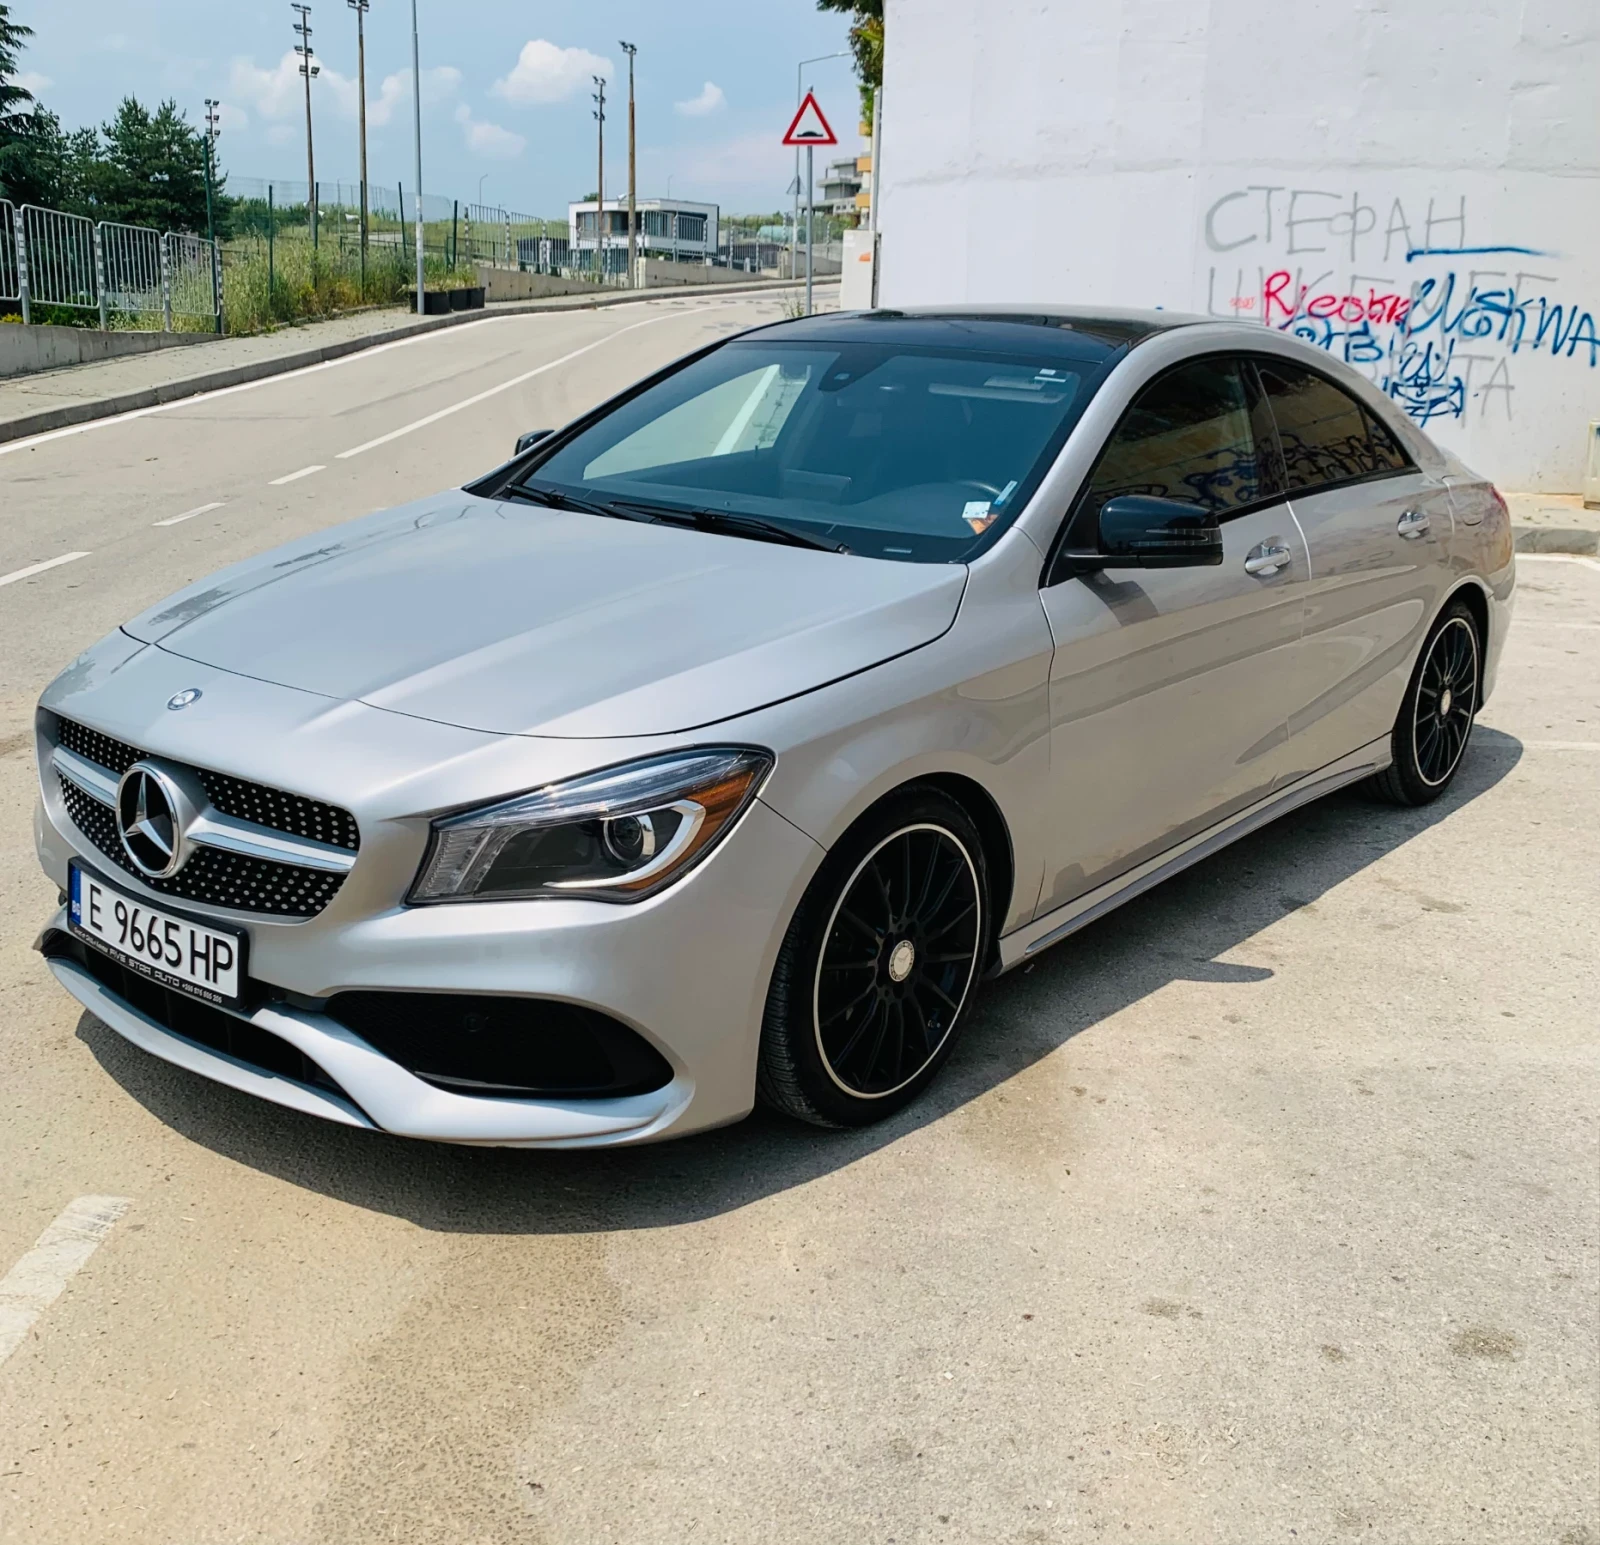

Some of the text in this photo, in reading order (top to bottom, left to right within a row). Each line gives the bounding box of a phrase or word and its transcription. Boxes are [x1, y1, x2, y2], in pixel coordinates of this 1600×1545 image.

[1205, 185, 1466, 263] СТЕФАН
[90, 883, 103, 933] E
[114, 900, 182, 968] 9665
[189, 929, 233, 984] HP
[128, 958, 151, 975] STAR
[154, 970, 180, 987] AUTO
